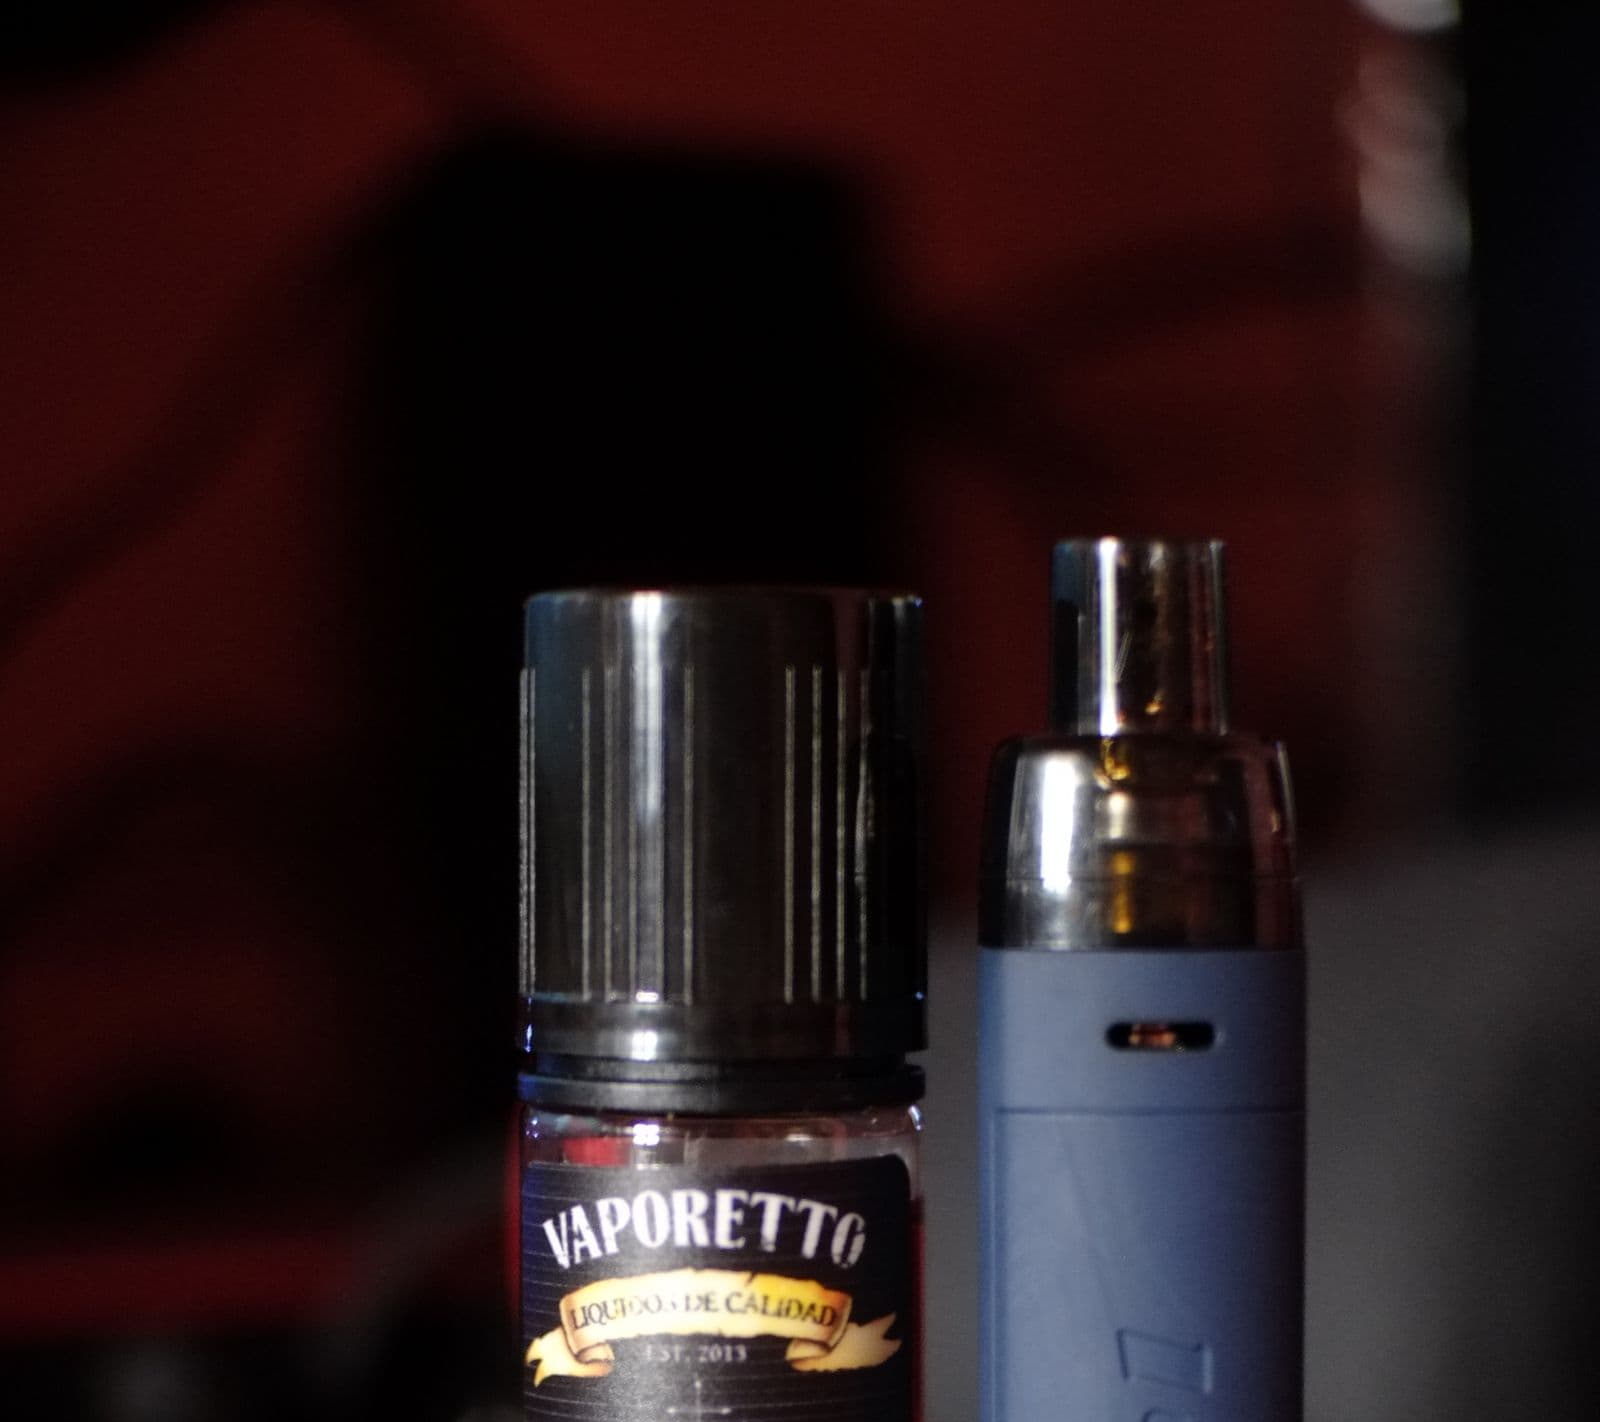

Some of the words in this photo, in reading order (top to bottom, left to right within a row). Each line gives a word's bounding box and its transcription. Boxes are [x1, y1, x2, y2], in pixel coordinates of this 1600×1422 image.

[543, 1188, 866, 1269] VAPORETTO
[684, 1292, 717, 1313] DE
[725, 1291, 836, 1327] CALIDAD
[699, 1343, 747, 1363] 2013
